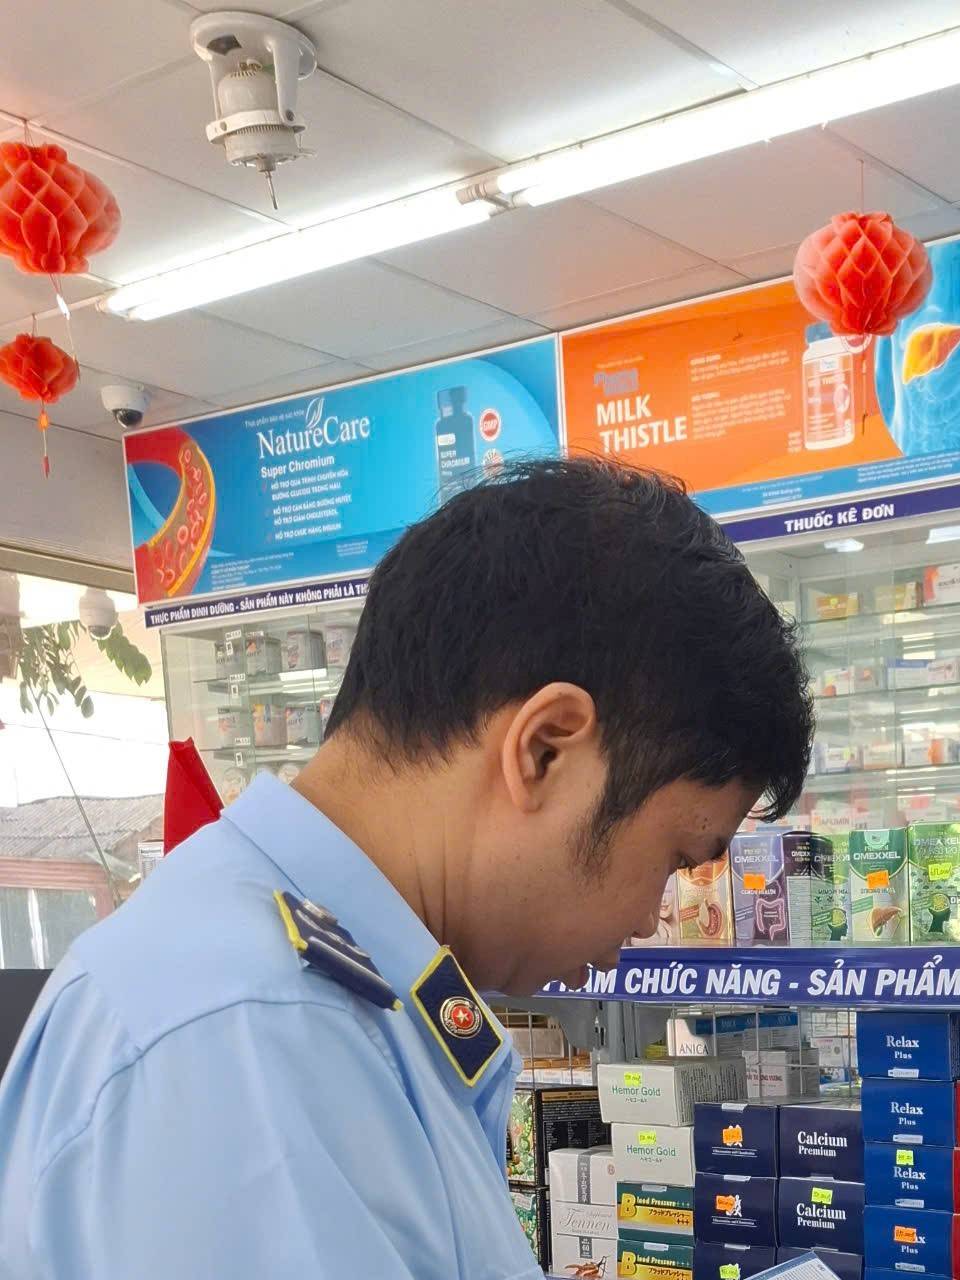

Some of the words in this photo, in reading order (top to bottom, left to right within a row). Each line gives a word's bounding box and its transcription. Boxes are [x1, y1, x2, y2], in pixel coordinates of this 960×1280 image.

[596, 395, 651, 427] MILK
[256, 416, 371, 459] NatureCare
[599, 416, 688, 452] THISTLE
[261, 465, 286, 479] Super
[289, 456, 335, 472] Chromium
[784, 509, 833, 533] THUỐC
[837, 509, 858, 524] KÊ
[862, 503, 895, 520] ĐƠN
[150, 610, 169, 624] THỰC
[170, 606, 190, 622] PHẨM
[191, 608, 208, 618] DINH
[256, 592, 278, 608] PHẨM
[279, 594, 295, 606] NÀY
[296, 589, 322, 602] KHÔNG
[323, 585, 342, 599] PHẢI
[344, 582, 355, 596] LÀ
[625, 961, 697, 995] CHỨC
[705, 963, 781, 996] NĂNG
[807, 958, 865, 996] SẢN
[679, 1043, 709, 1056] ANICA
[886, 1035, 920, 1049] Relax
[894, 1051, 912, 1060] Plus
[612, 1085, 638, 1095] Hemor
[641, 1086, 661, 1096] Gold
[890, 1102, 924, 1115] Relax
[797, 1131, 848, 1148] Calcium
[798, 1146, 837, 1157] Premium
